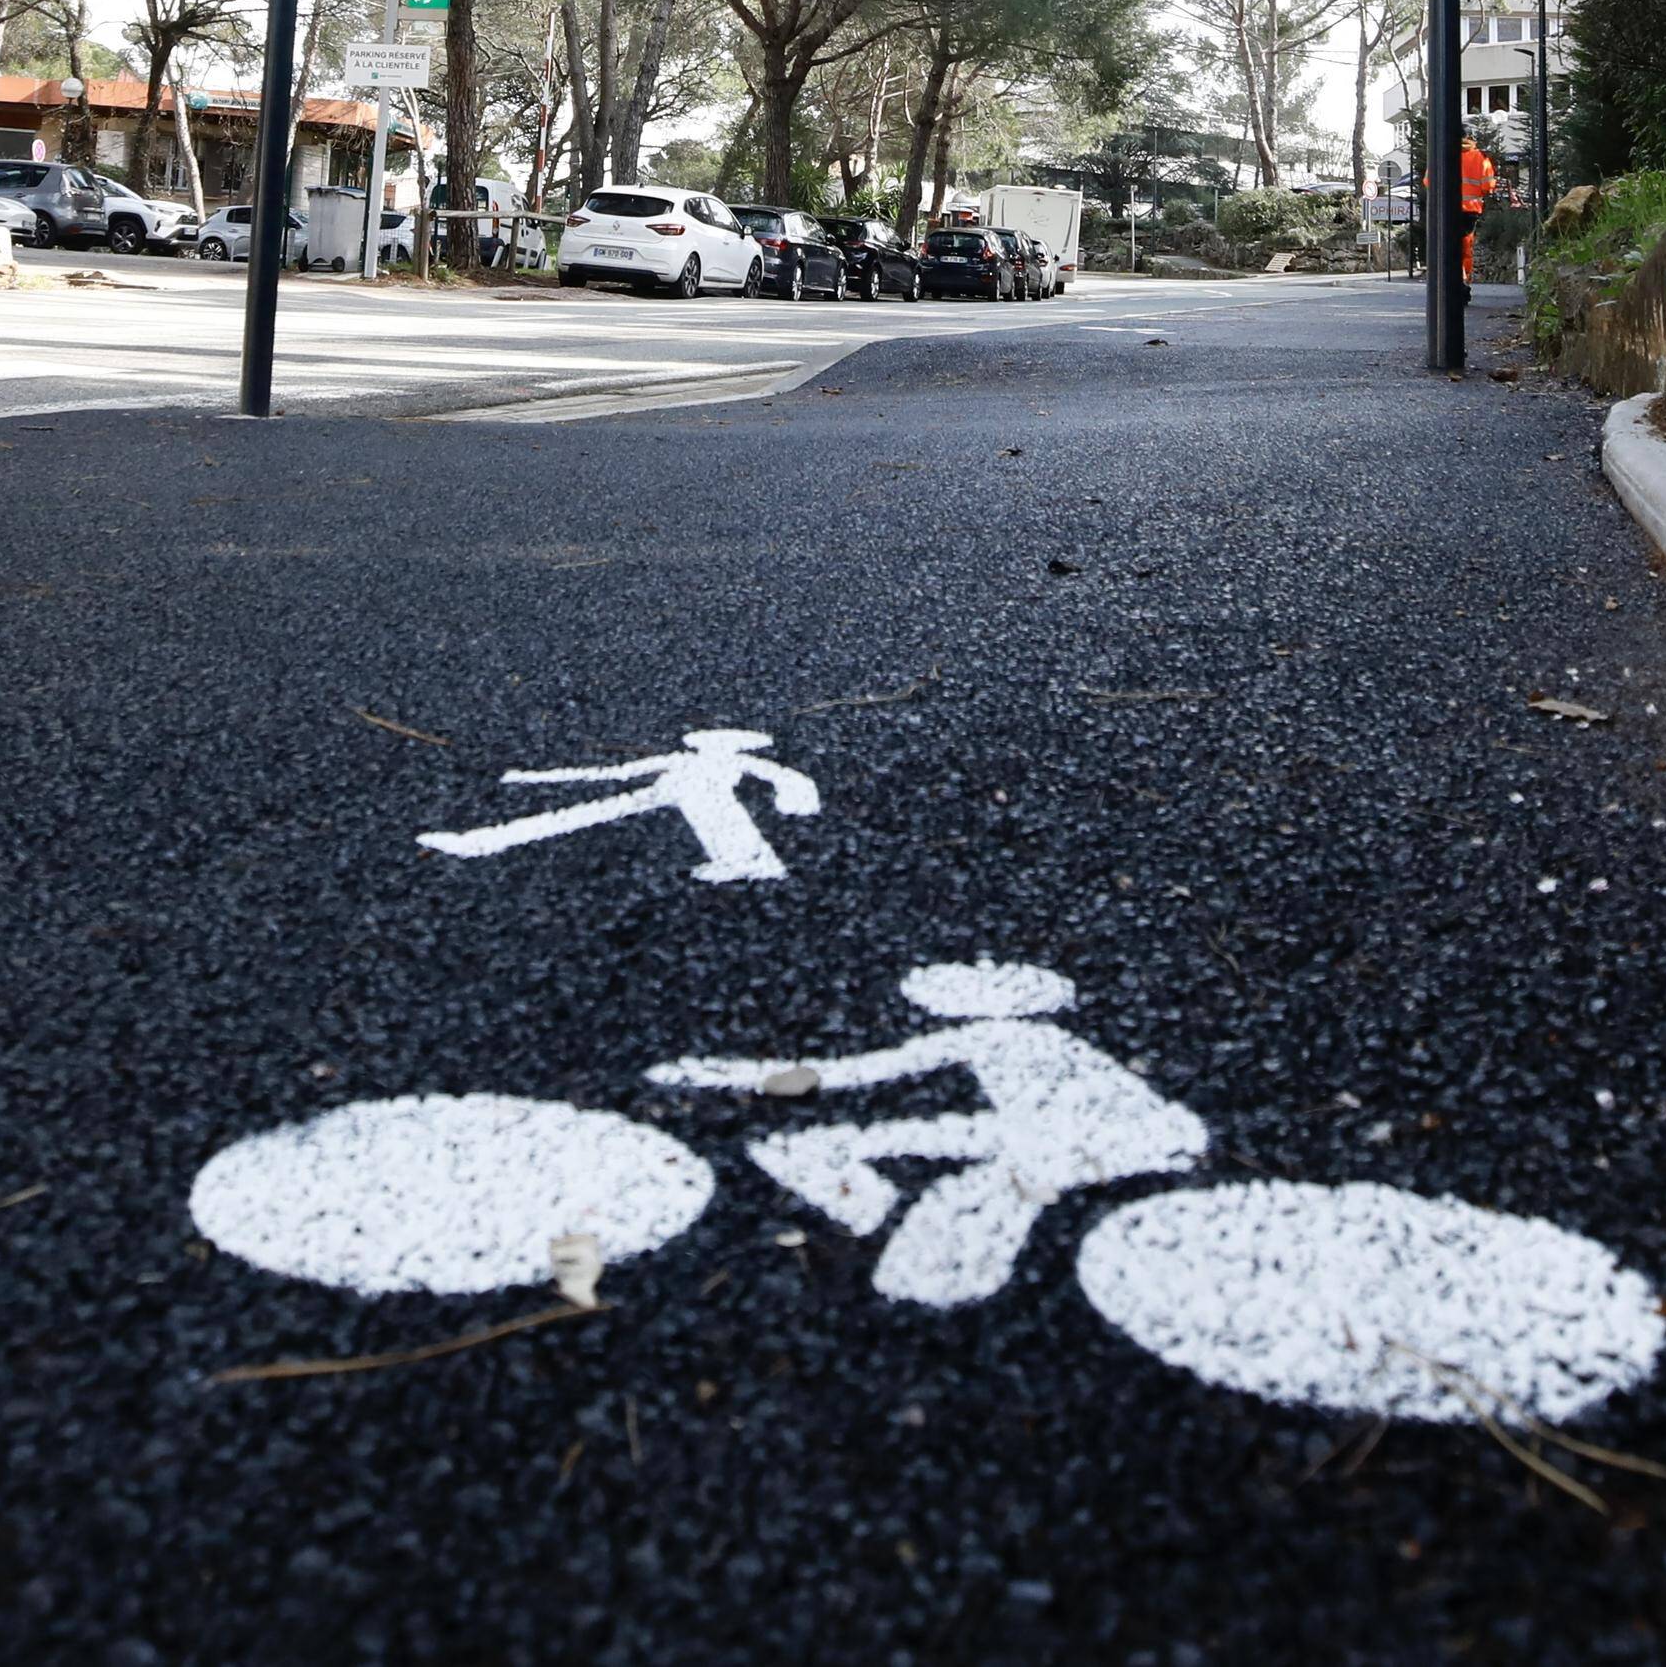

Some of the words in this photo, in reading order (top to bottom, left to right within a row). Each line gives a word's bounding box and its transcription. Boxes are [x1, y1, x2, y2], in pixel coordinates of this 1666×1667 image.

[349, 50, 387, 59] PARKING
[388, 51, 427, 60] RÉSERVÉ
[354, 60, 361, 68] À
[362, 61, 373, 69] LA
[375, 61, 421, 70] CLIENTÈLE
